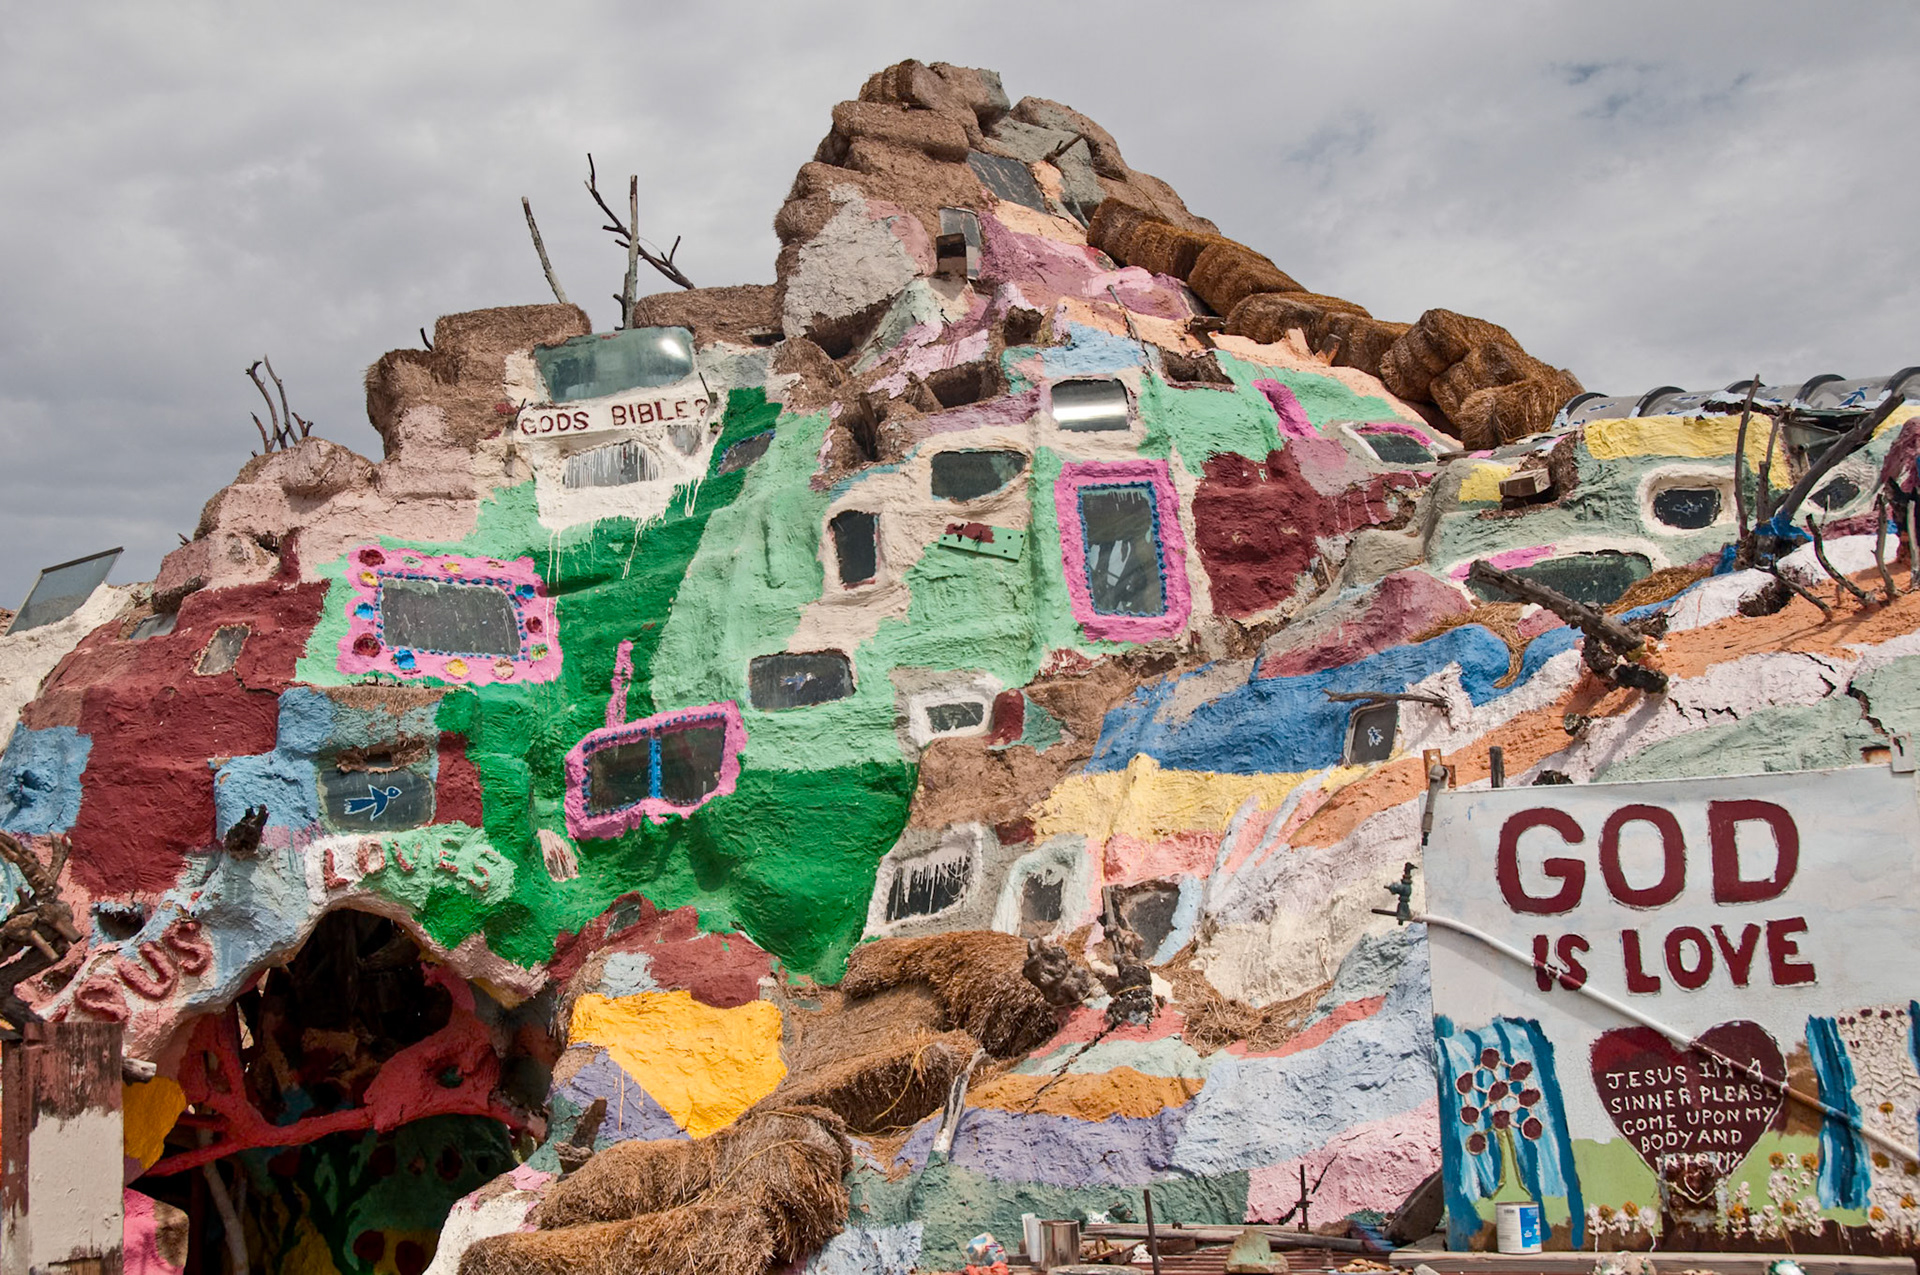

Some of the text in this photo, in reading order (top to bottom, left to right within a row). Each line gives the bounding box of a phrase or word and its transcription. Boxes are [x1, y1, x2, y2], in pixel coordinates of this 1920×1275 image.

[520, 411, 590, 435] GODS
[324, 838, 502, 892] LOVES
[1496, 799, 1800, 915] GOD
[1531, 916, 1819, 996] IS LOVE
[1605, 1065, 1688, 1090] JESUS
[1747, 1057, 1764, 1082] A
[1611, 1083, 1778, 1114] SINNER PLEASE
[1622, 1106, 1774, 1136] COME UPON MY
[1641, 1129, 1742, 1154] BODY AND
